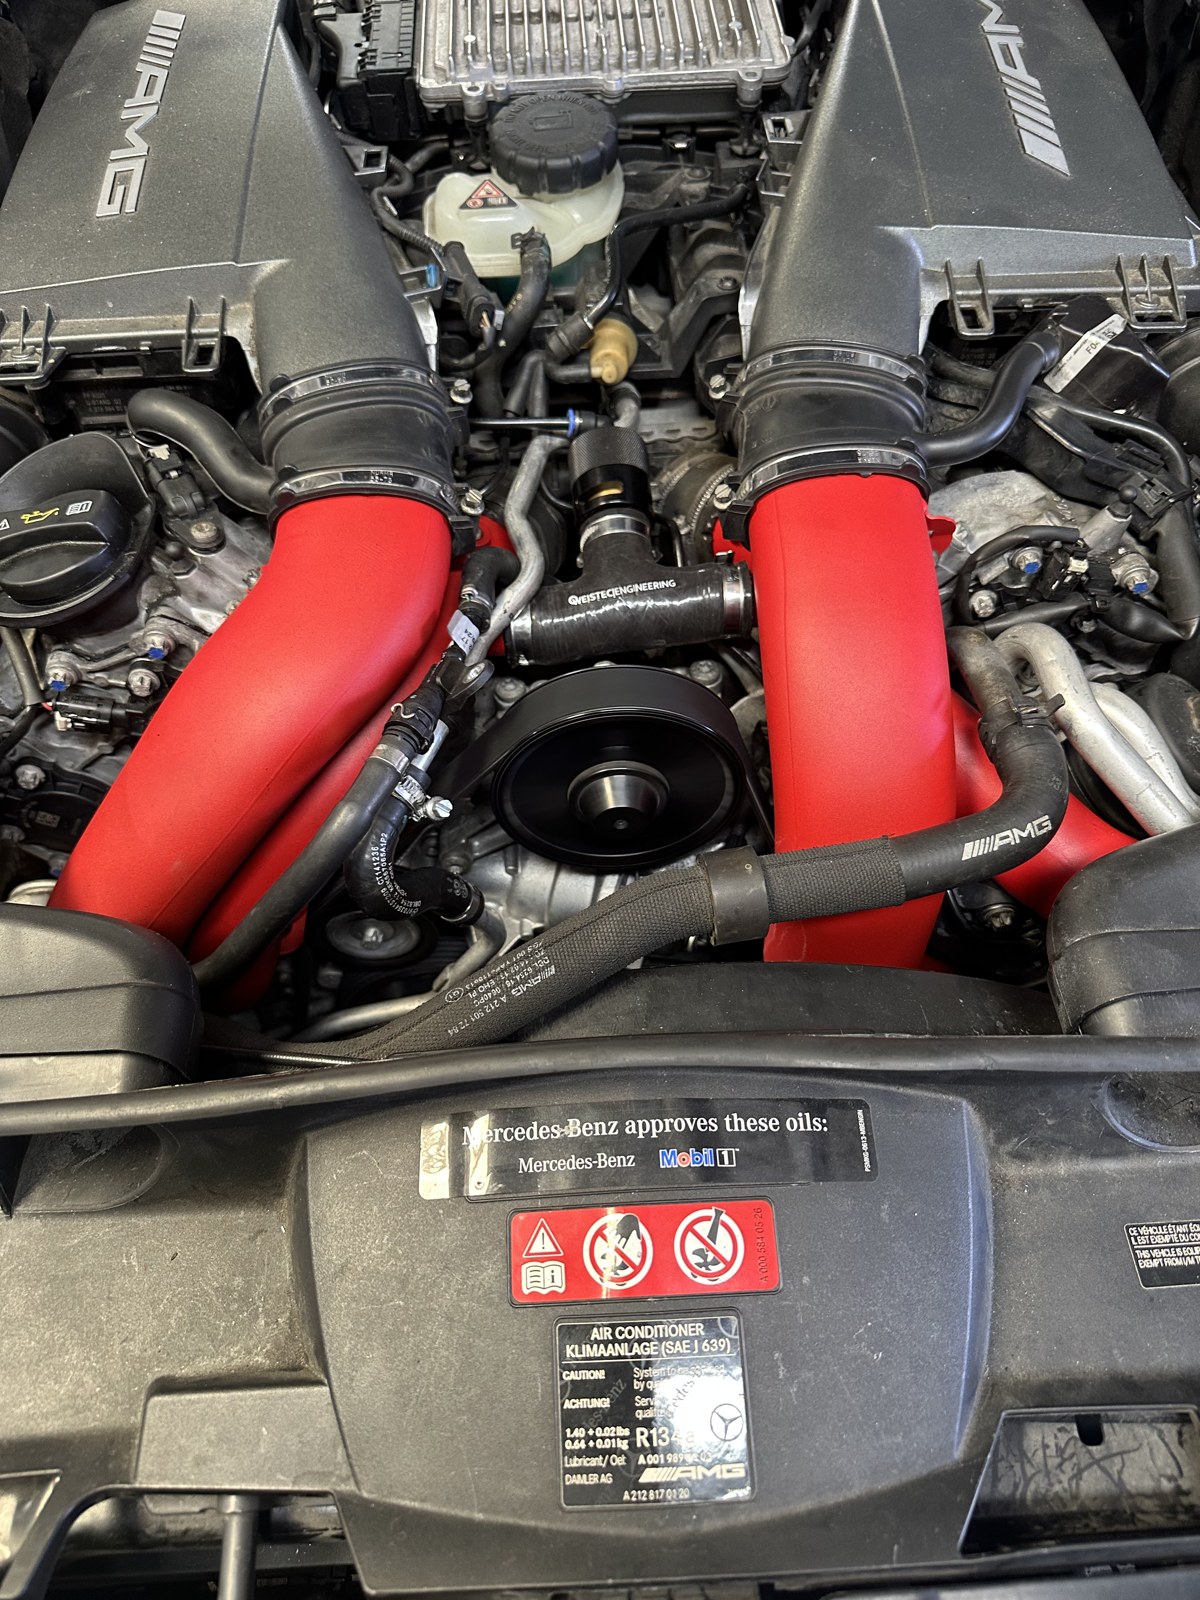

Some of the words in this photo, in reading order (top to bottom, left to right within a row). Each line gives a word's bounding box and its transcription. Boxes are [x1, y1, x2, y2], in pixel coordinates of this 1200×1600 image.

[96, 62, 170, 218] AMG
[993, 815, 1053, 852] AMG
[500, 995, 507, 1003] A
[484, 1000, 500, 1013] 212
[471, 1010, 484, 1022] 501
[458, 1018, 470, 1030] 72
[447, 1026, 459, 1037] 84
[625, 1116, 718, 1139] approves
[724, 1112, 780, 1132] these
[786, 1112, 828, 1132] oils:
[518, 1152, 636, 1174] Mercedes-Benz
[659, 1148, 715, 1168] Mobil
[754, 1207, 763, 1219] 26
[755, 1221, 764, 1234] 05
[1128, 1227, 1138, 1236] CE
[757, 1236, 766, 1253] 584
[1137, 1235, 1150, 1245] EST
[1150, 1233, 1179, 1244] EXEMPTÉ
[1179, 1233, 1189, 1242] DU
[1135, 1249, 1150, 1258] THIS
[1150, 1248, 1176, 1258] VEHICLE
[1176, 1247, 1183, 1256] IS
[758, 1255, 768, 1273] 000
[1138, 1258, 1164, 1268] EXEMPT
[1164, 1257, 1183, 1267] FROM
[590, 1327, 613, 1341] AIR
[615, 1323, 705, 1340] CONDITIONER
[566, 1342, 659, 1358] KLIMAANLAGE
[661, 1340, 690, 1357] (SAE
[693, 1340, 698, 1354] J
[702, 1339, 731, 1354] 639)
[562, 1370, 606, 1381] CAUTION!
[633, 1366, 666, 1380] System
[633, 1379, 645, 1391] by
[563, 1398, 610, 1409] ACHTUNG!
[565, 1427, 585, 1438] 1.40
[595, 1426, 615, 1437] 0.02
[616, 1425, 630, 1437] lbs
[565, 1439, 586, 1450] 0.64
[596, 1438, 616, 1449] 0.01
[617, 1438, 629, 1451] kg
[638, 1455, 646, 1465] A
[646, 1454, 665, 1465] 001
[675, 1463, 746, 1480] AMG
[565, 1474, 599, 1486] DAIMLER
[600, 1473, 613, 1484] AG
[623, 1490, 631, 1501] A
[631, 1489, 647, 1501] 212
[667, 1488, 678, 1499] 01
[678, 1487, 689, 1499] 20
